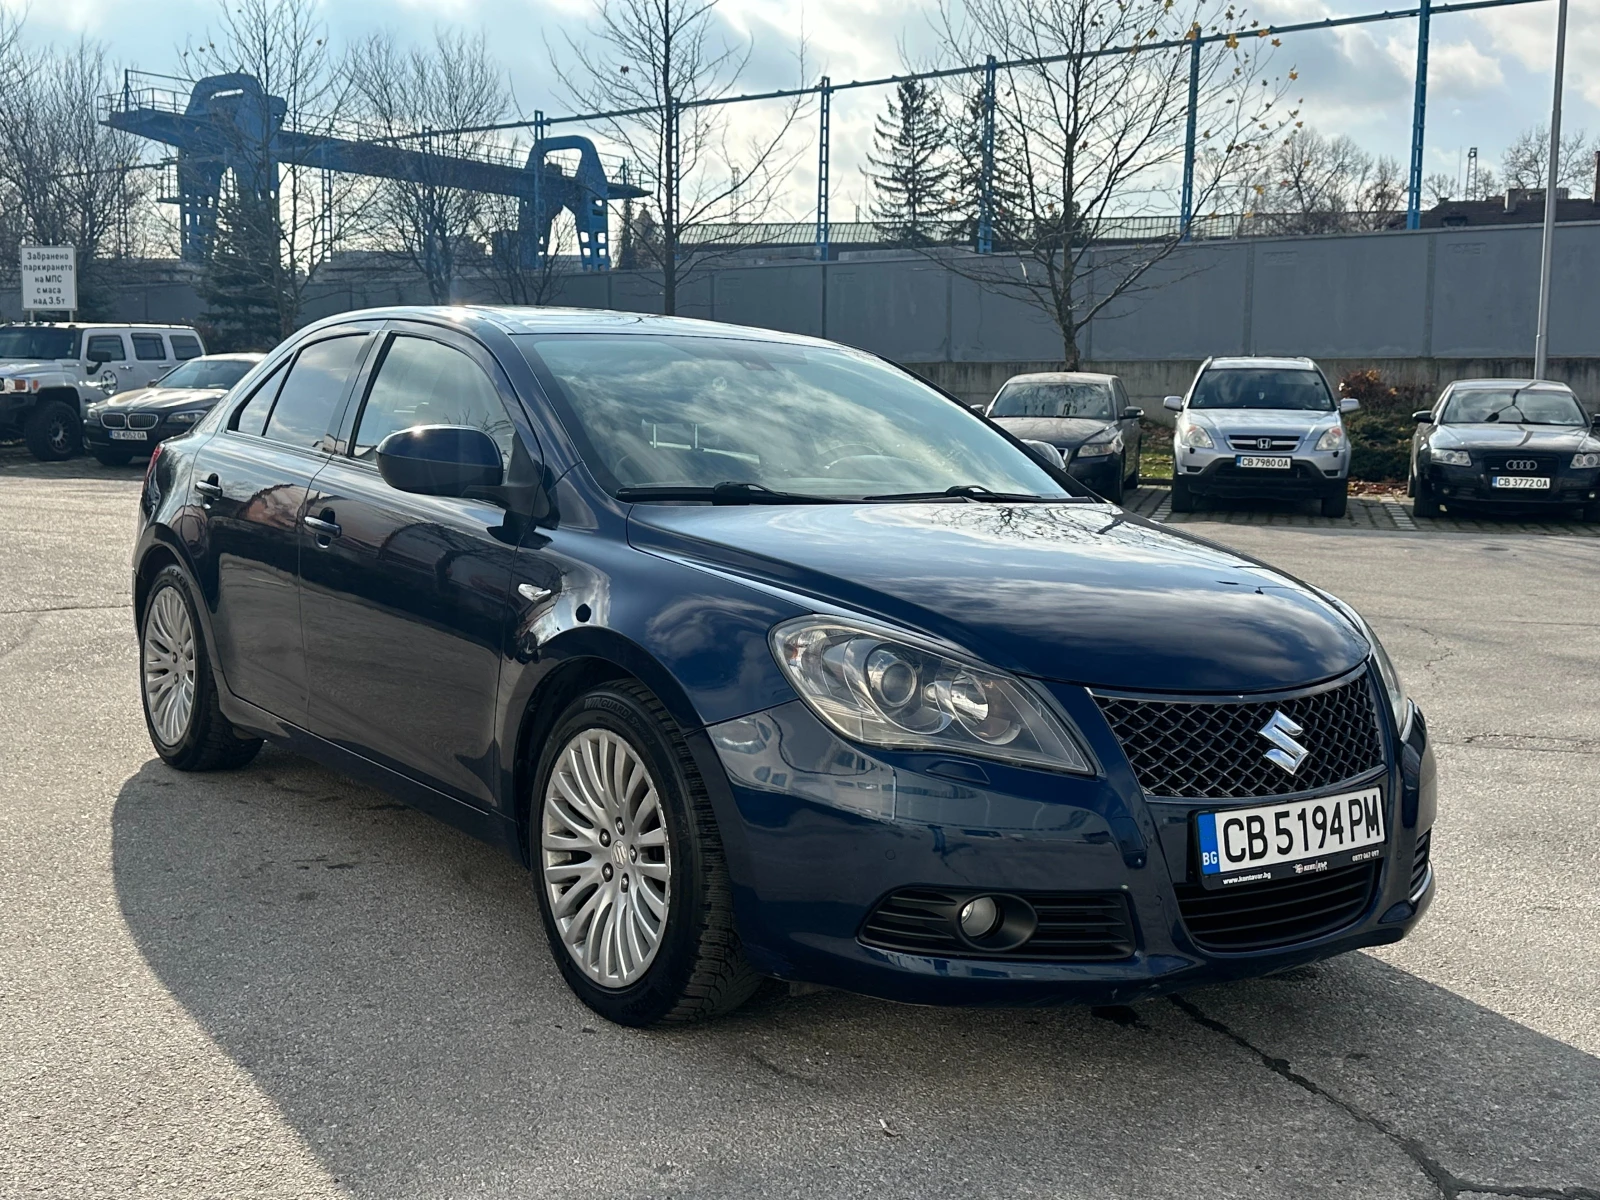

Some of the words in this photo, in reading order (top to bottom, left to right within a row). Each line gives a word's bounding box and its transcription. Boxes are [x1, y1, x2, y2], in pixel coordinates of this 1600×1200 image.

[27, 251, 69, 262] Забранено
[23, 264, 73, 272] паркирането
[45, 274, 62, 283] МПС
[1242, 457, 1254, 466] CB
[1255, 458, 1277, 467] 7980
[1277, 458, 1289, 467] OA
[1498, 477, 1510, 487] CB
[1511, 478, 1535, 487] 3772
[1535, 478, 1548, 487] OA
[166, 567, 189, 591] NEXEN
[584, 696, 632, 719] WINGUARD
[1222, 814, 1269, 863] CB
[1274, 801, 1345, 855] 5194
[1348, 794, 1381, 842] PM
[1202, 851, 1218, 866] BG
